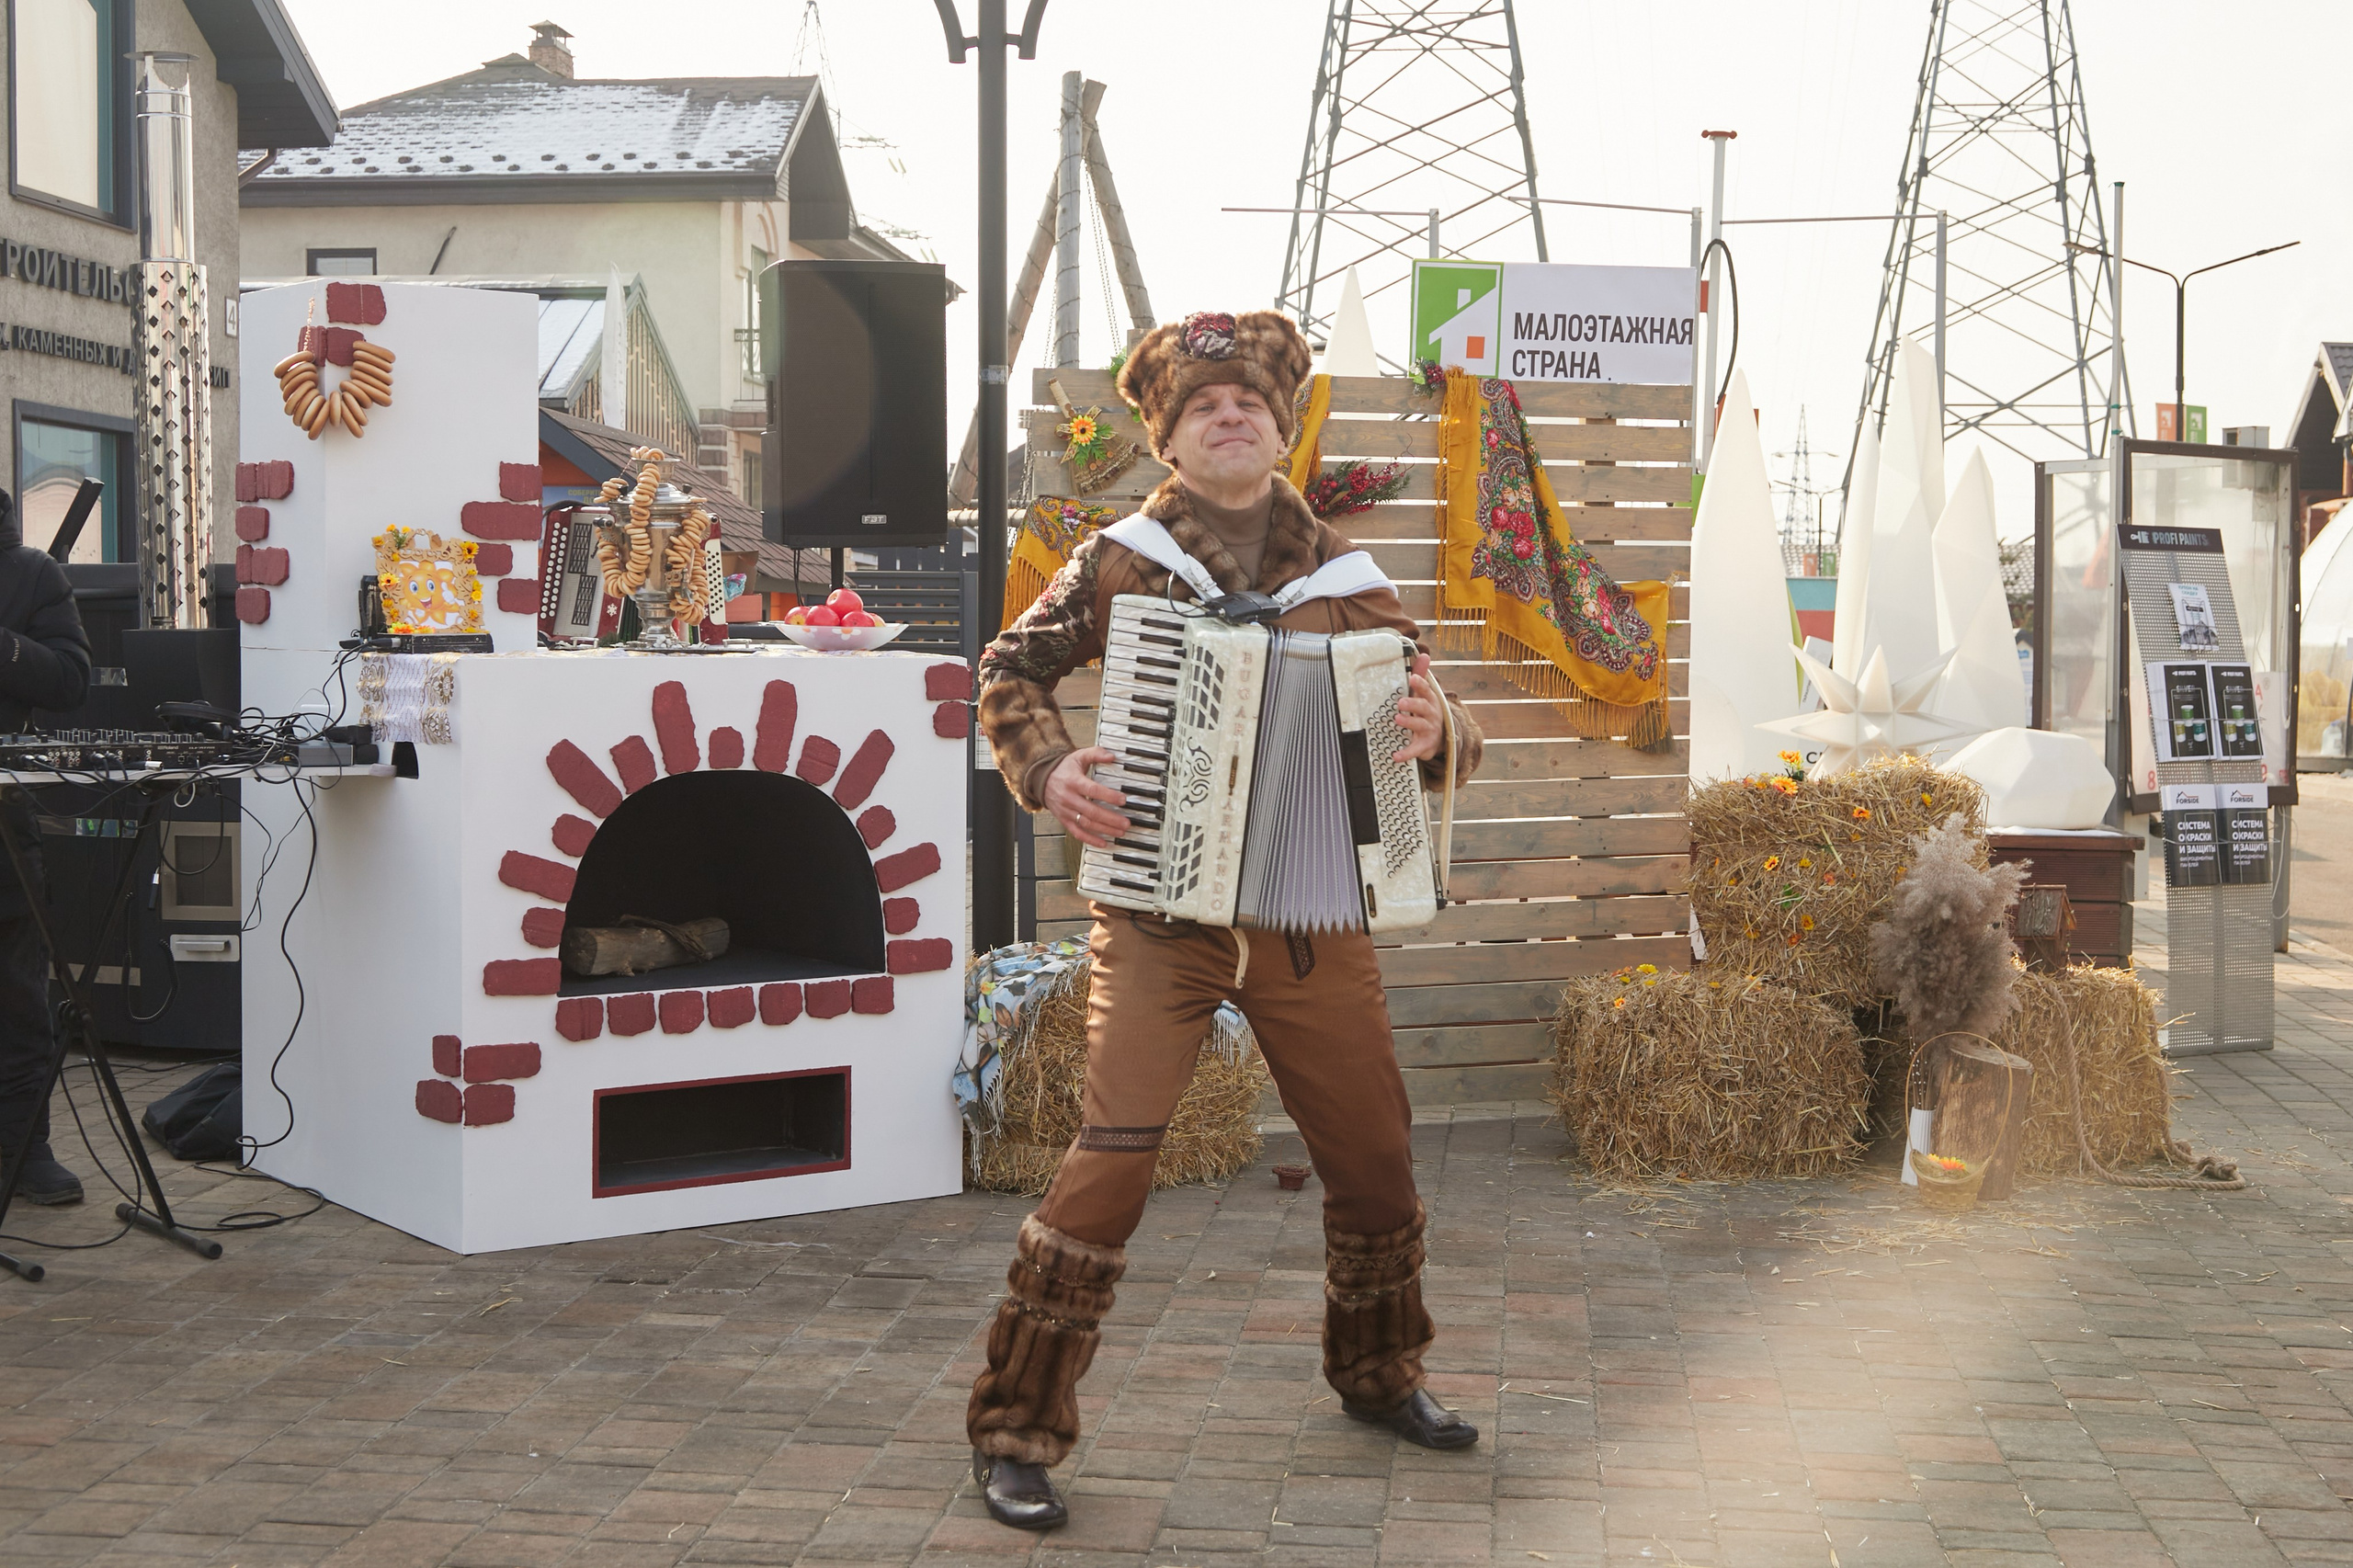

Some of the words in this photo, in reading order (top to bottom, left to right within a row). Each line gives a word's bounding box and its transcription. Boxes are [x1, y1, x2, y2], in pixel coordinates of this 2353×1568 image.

[0, 237, 131, 304] РОИТЕЛЬ
[228, 305, 235, 330] 4
[1514, 312, 1694, 346] МАЛОЭТАЖНАЯ
[17, 325, 107, 366] КАМЕННЫХ
[112, 346, 122, 369] И
[1512, 349, 1601, 379] СТРАНА
[2152, 531, 2178, 545] PROFI
[2178, 532, 2210, 547] PAINTS
[2177, 821, 2211, 830] СИСТЕМА
[2232, 820, 2264, 829] СИСТЕМА
[2178, 833, 2212, 842] ОКРАСКИ
[2232, 832, 2264, 840] ОКРАСКИ
[1211, 801, 1233, 911] ARMANDO
[2179, 846, 2186, 854] И
[2187, 845, 2216, 854] ЗАЩИТЫ
[2233, 844, 2239, 852] И
[2240, 844, 2268, 852] ЗАЩИТЫ
